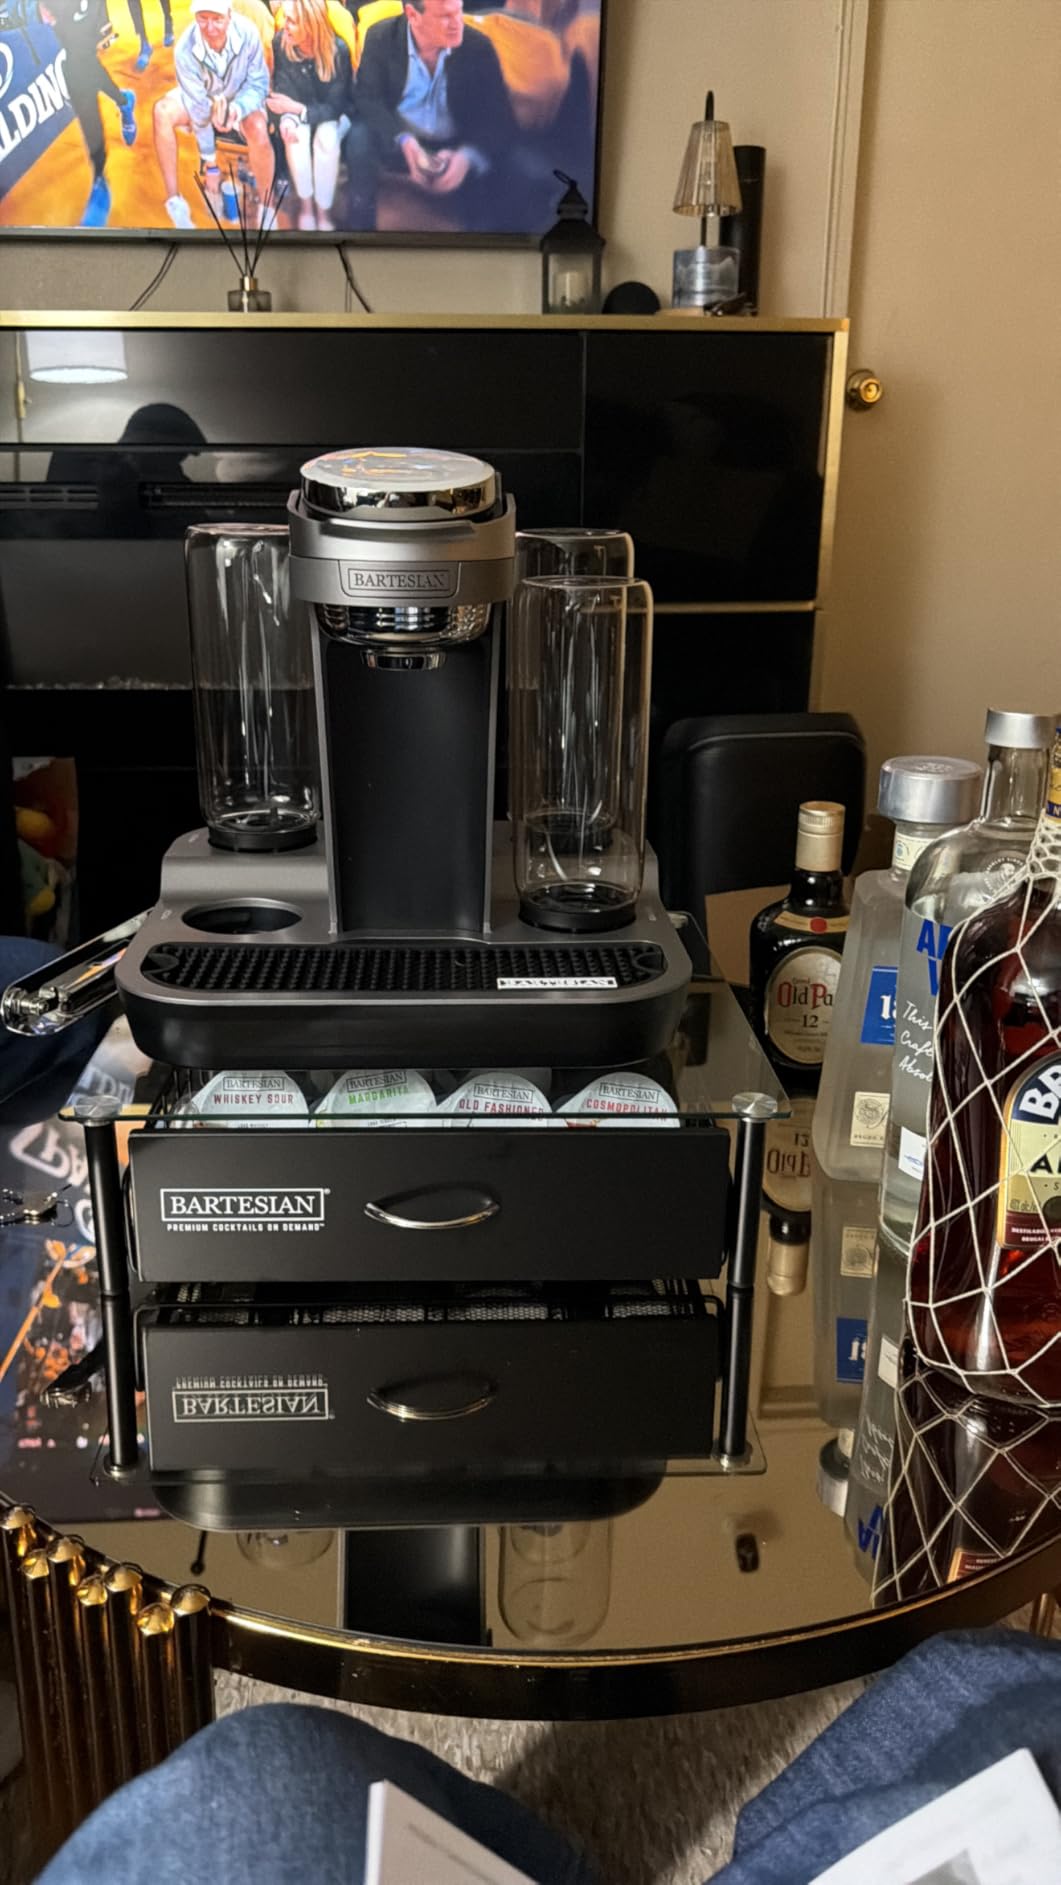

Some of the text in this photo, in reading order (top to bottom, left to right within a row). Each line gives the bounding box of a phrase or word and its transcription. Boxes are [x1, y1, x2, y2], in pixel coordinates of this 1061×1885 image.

[354, 573, 445, 588] BARTESIAN
[777, 981, 833, 1009] Old Pa
[801, 1015, 819, 1028] 12
[902, 1000, 933, 1031] This
[213, 1094, 294, 1105] WHISKEY SOUR
[348, 1085, 409, 1105] MARGARITA
[458, 1098, 479, 1110] OLD
[170, 1195, 316, 1215] BARTESIAN
[166, 1223, 209, 1232] PREMIUM
[212, 1223, 264, 1232] COCKTAILS
[267, 1223, 279, 1232] ON
